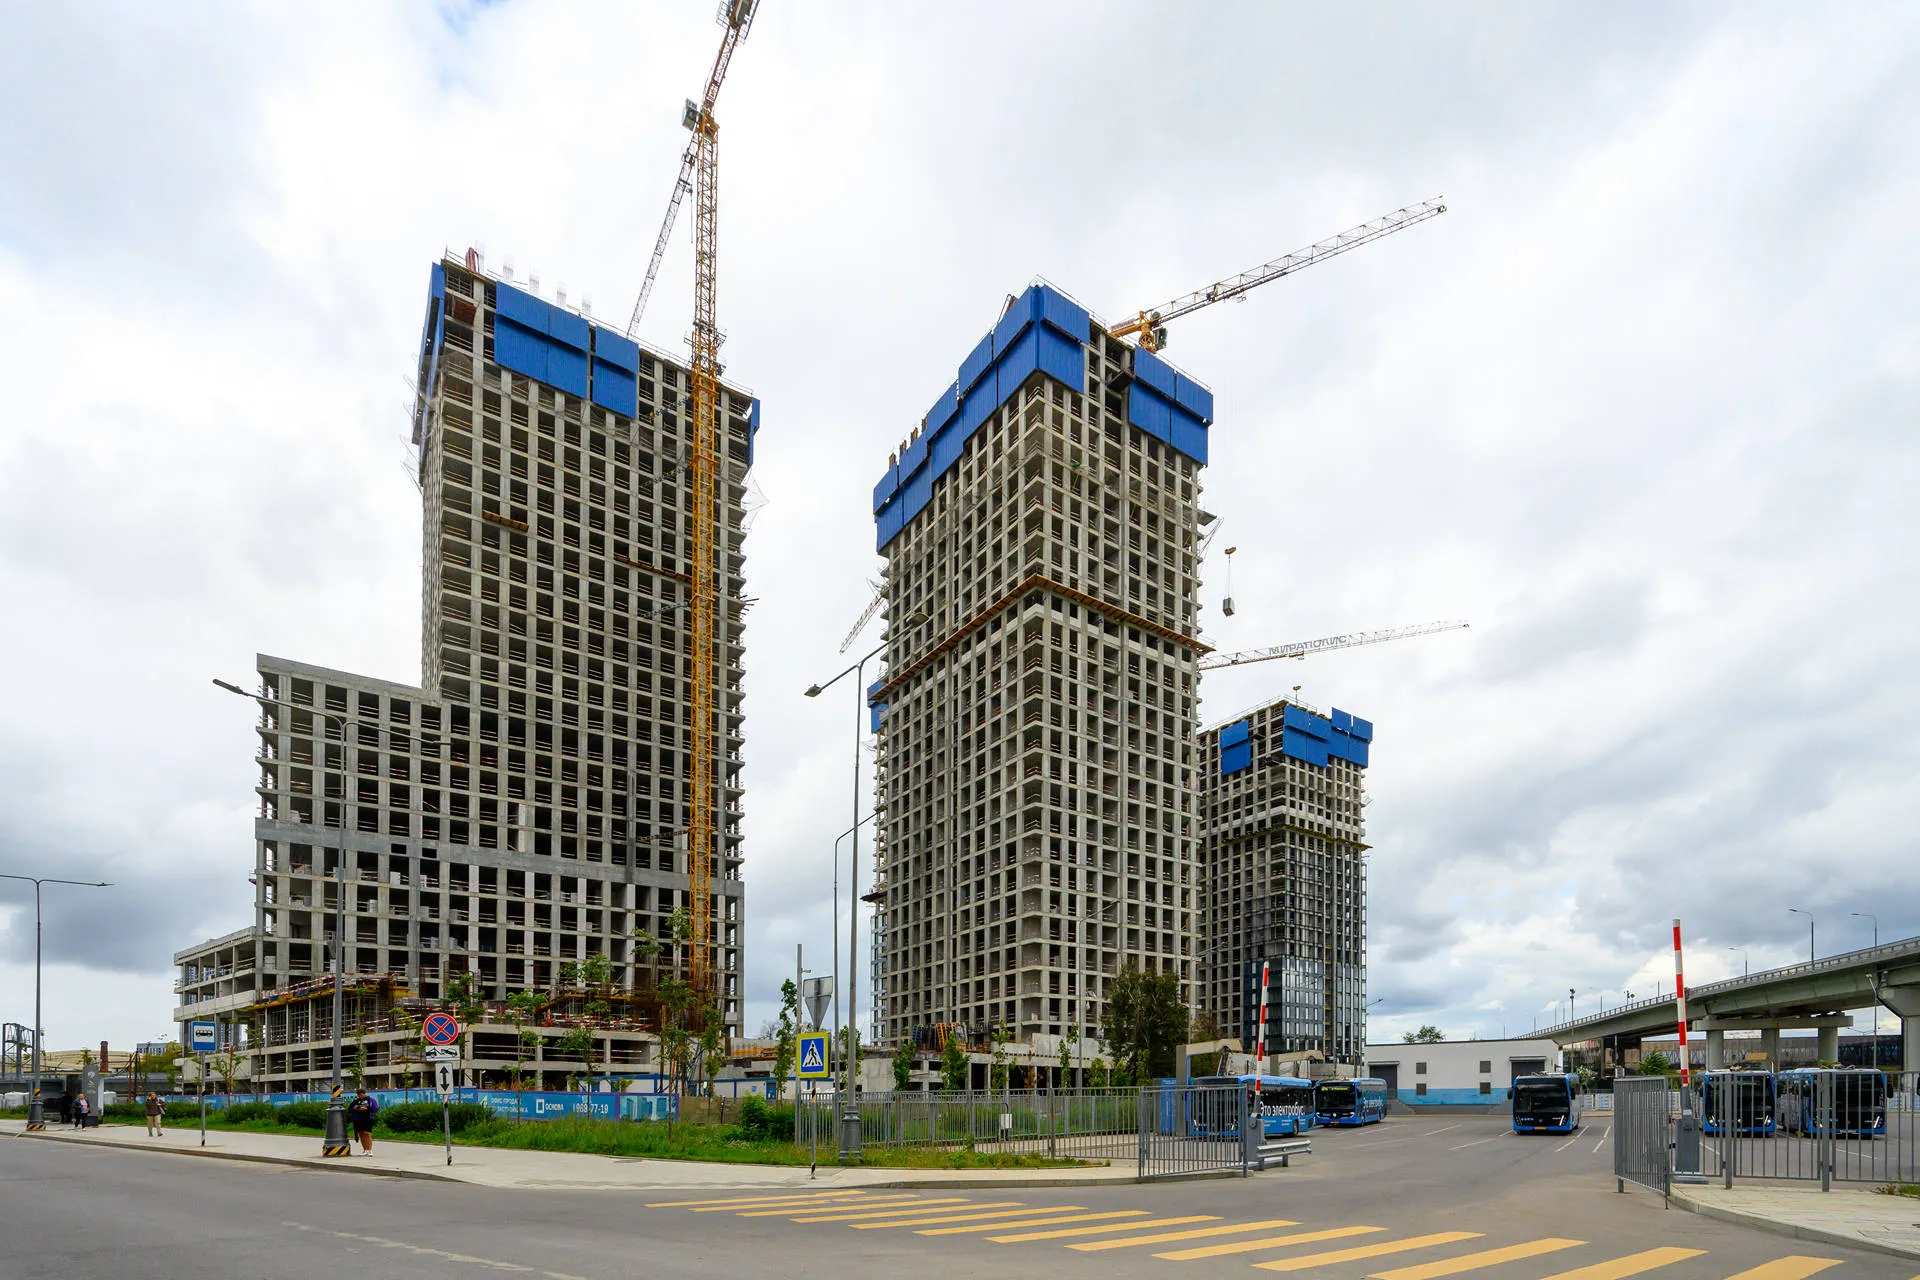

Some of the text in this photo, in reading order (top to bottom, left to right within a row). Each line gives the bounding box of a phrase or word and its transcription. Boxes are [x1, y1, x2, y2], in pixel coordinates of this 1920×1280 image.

[1269, 635, 1347, 655] МИРАПОЛИС
[545, 1103, 564, 1111] ОСНОВА
[1260, 1101, 1272, 1116] Это
